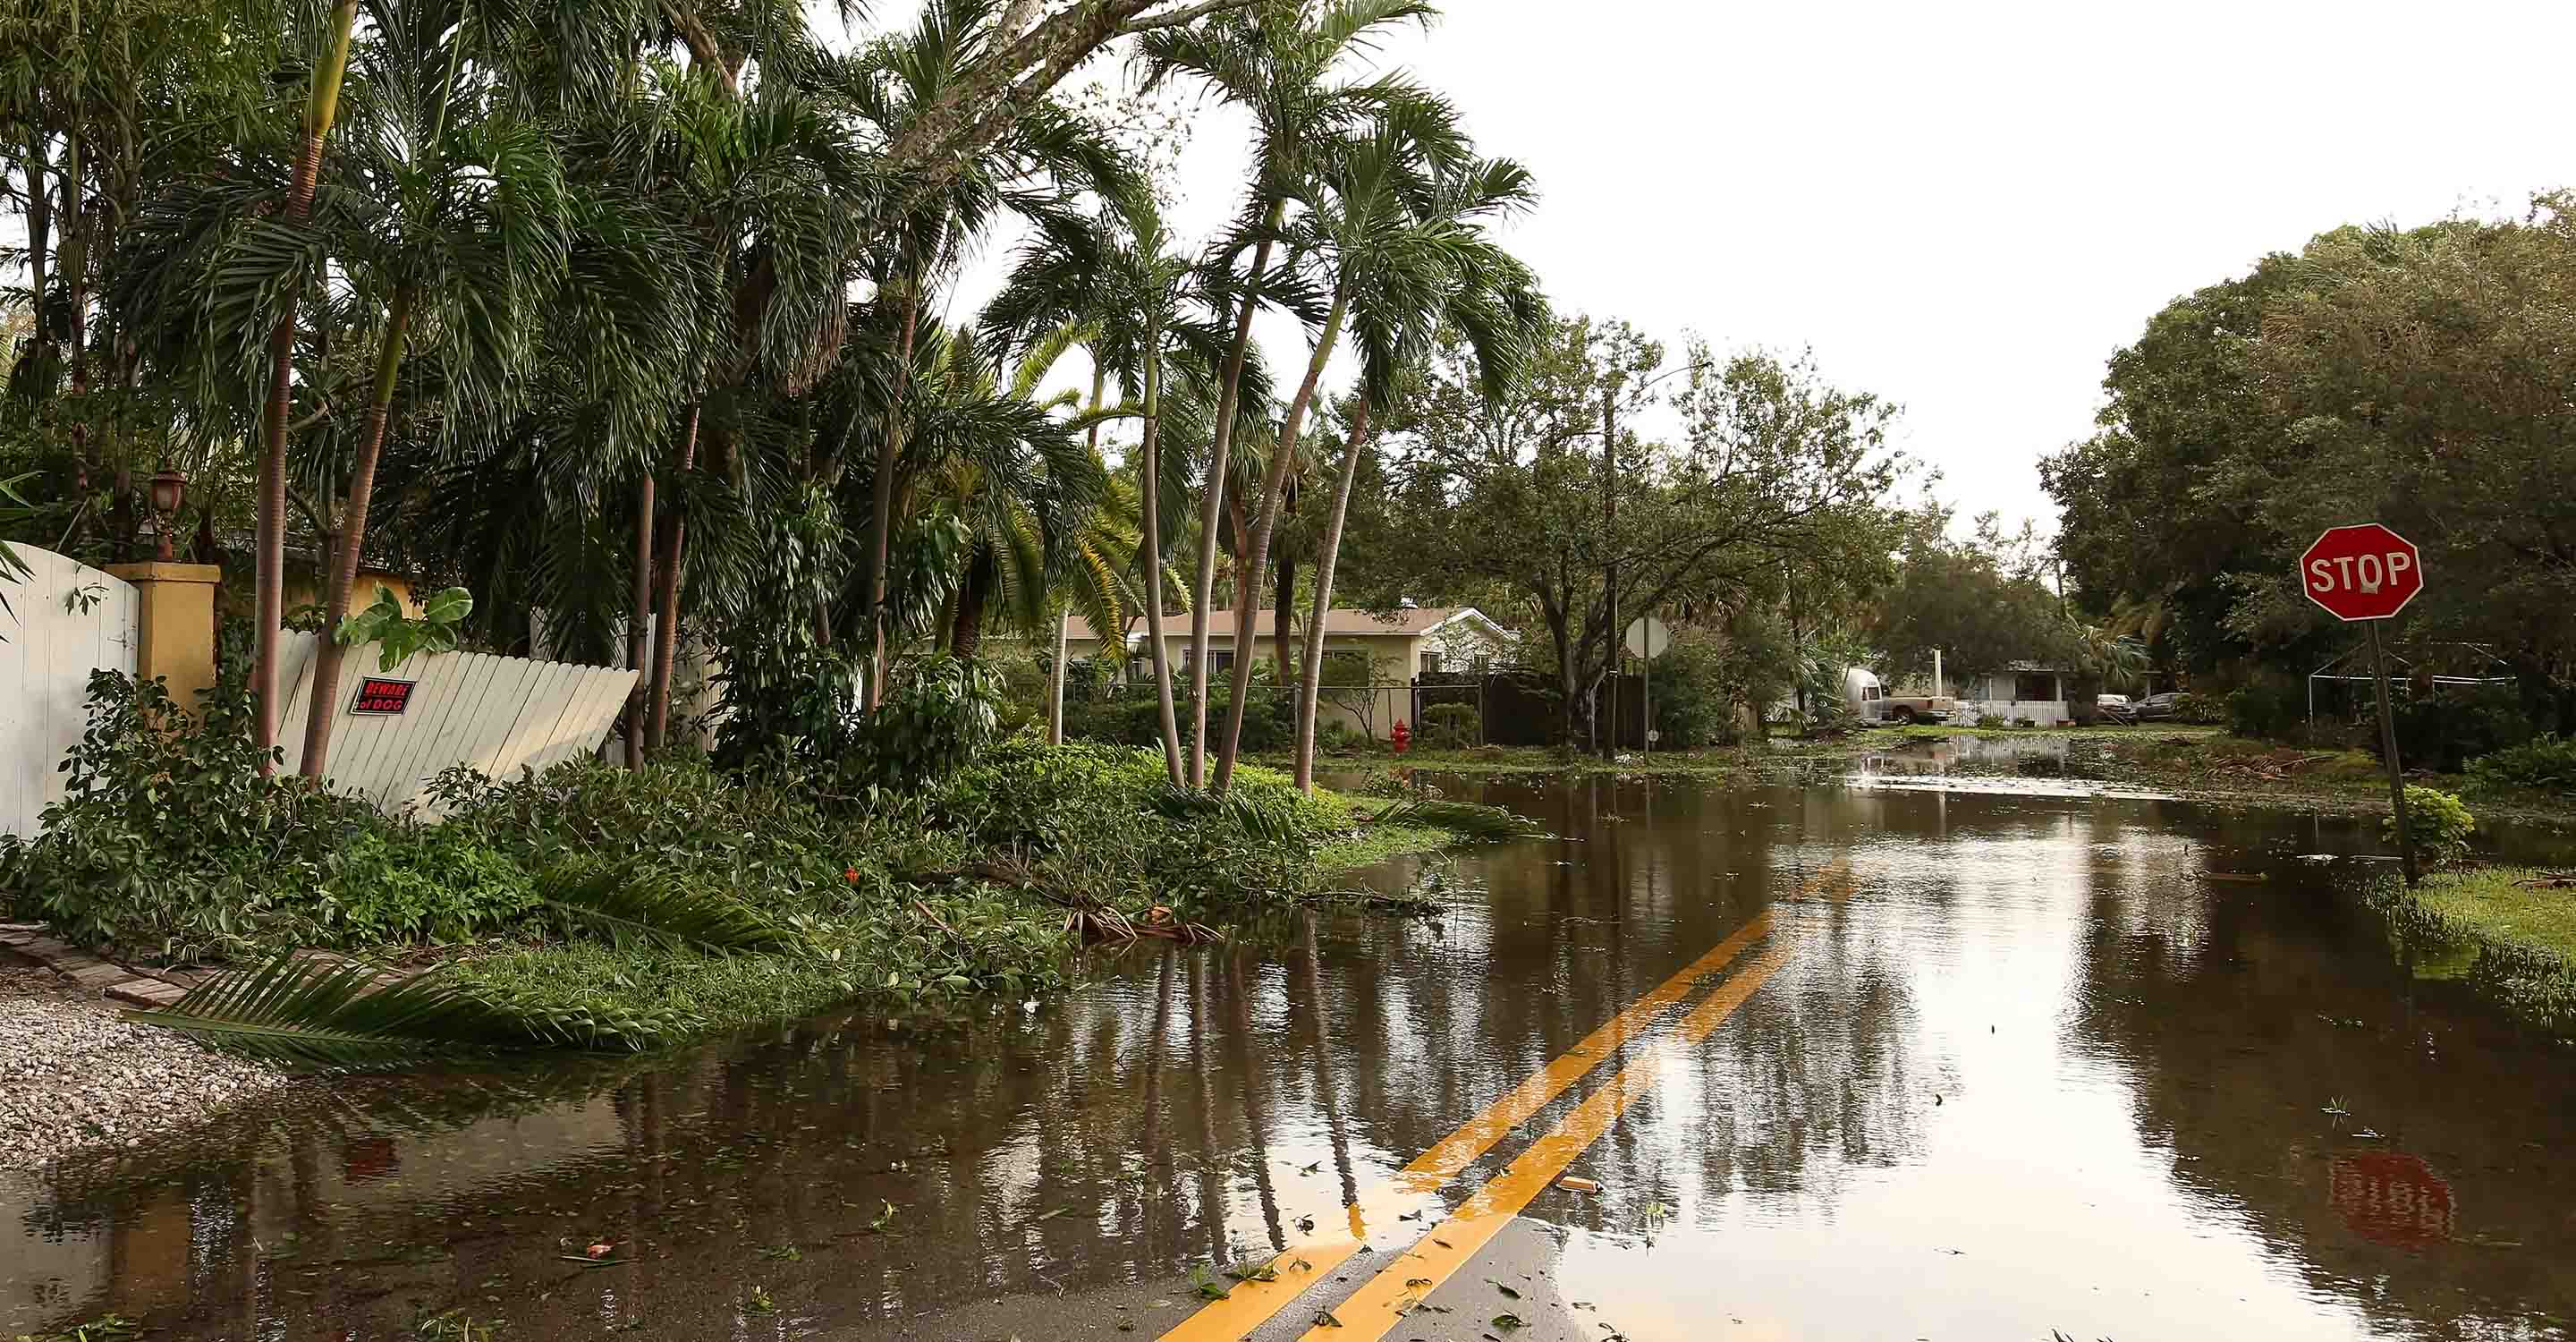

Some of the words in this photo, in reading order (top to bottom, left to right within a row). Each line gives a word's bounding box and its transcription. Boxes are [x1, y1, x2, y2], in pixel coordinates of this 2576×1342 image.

[2310, 552, 2411, 592] STOP
[365, 681, 410, 695] BEWARE
[360, 700, 371, 709] of
[372, 699, 402, 709] DOG
